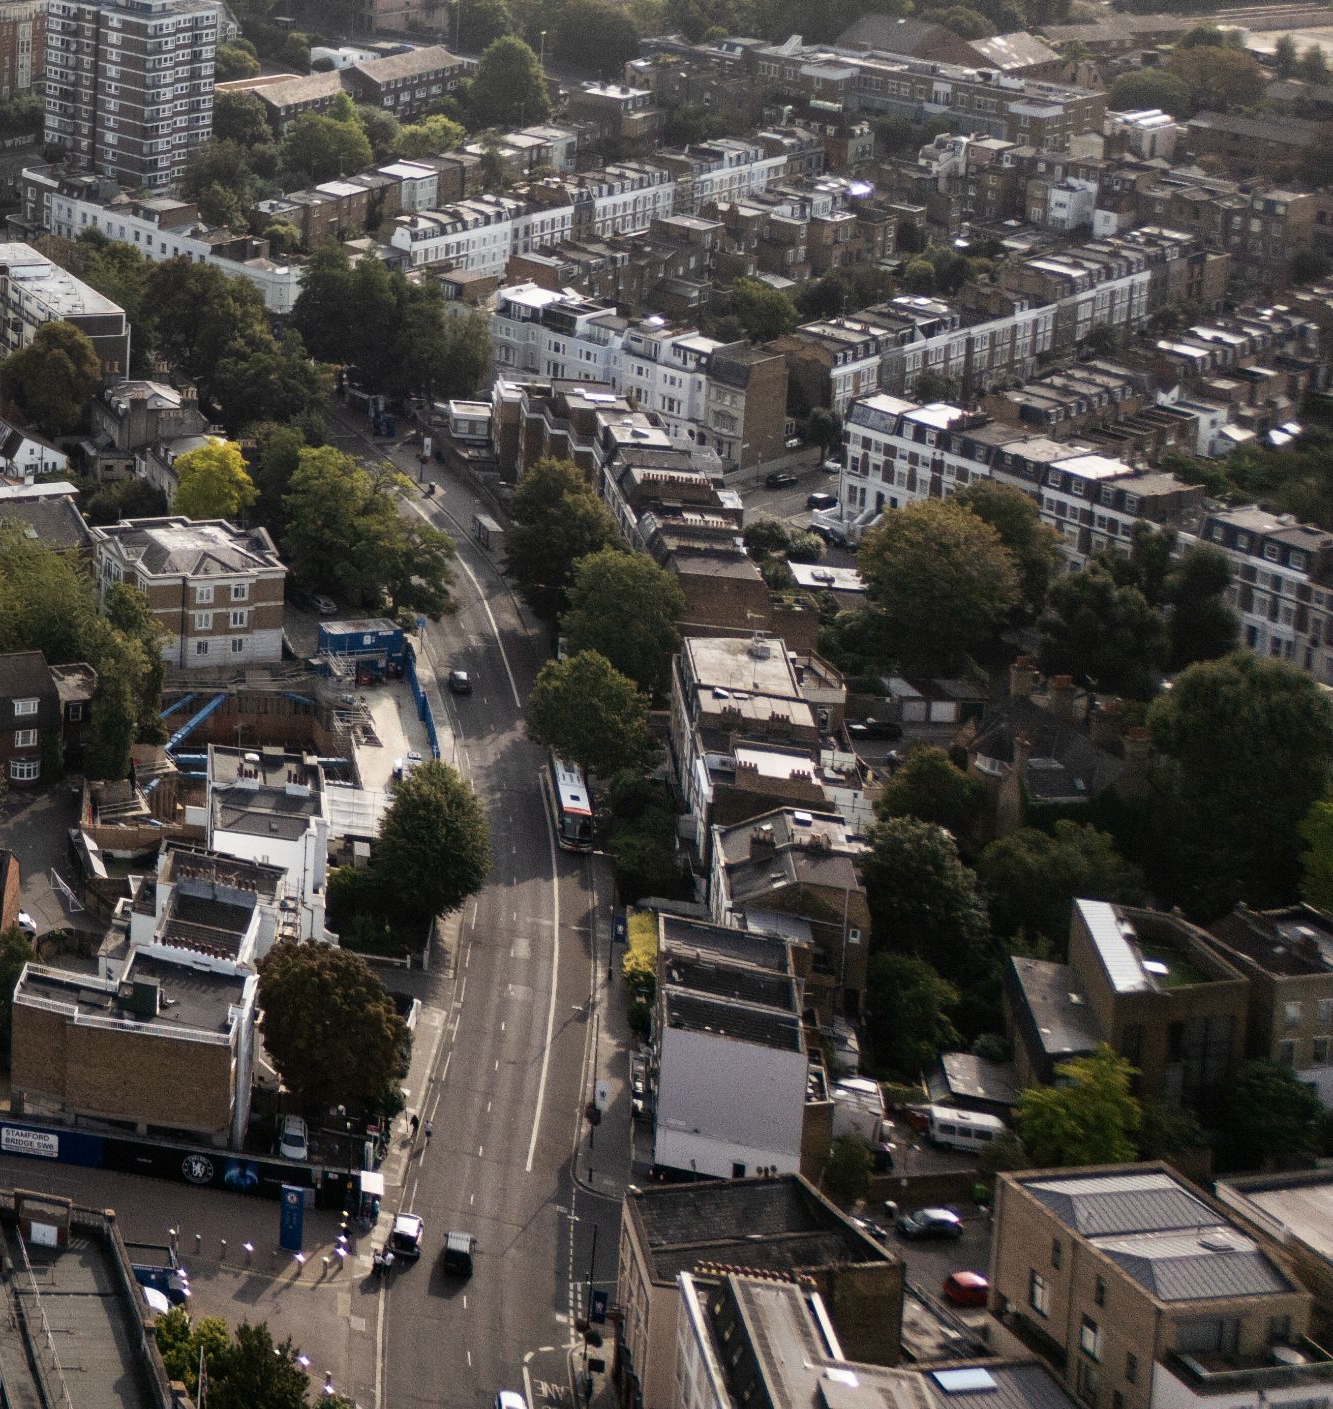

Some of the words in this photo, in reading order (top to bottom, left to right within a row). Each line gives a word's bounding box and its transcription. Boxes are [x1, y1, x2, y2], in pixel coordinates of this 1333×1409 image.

[5, 1129, 50, 1142] STAMFORD
[5, 1137, 35, 1148] BRIDGE
[36, 1141, 54, 1150] SW6
